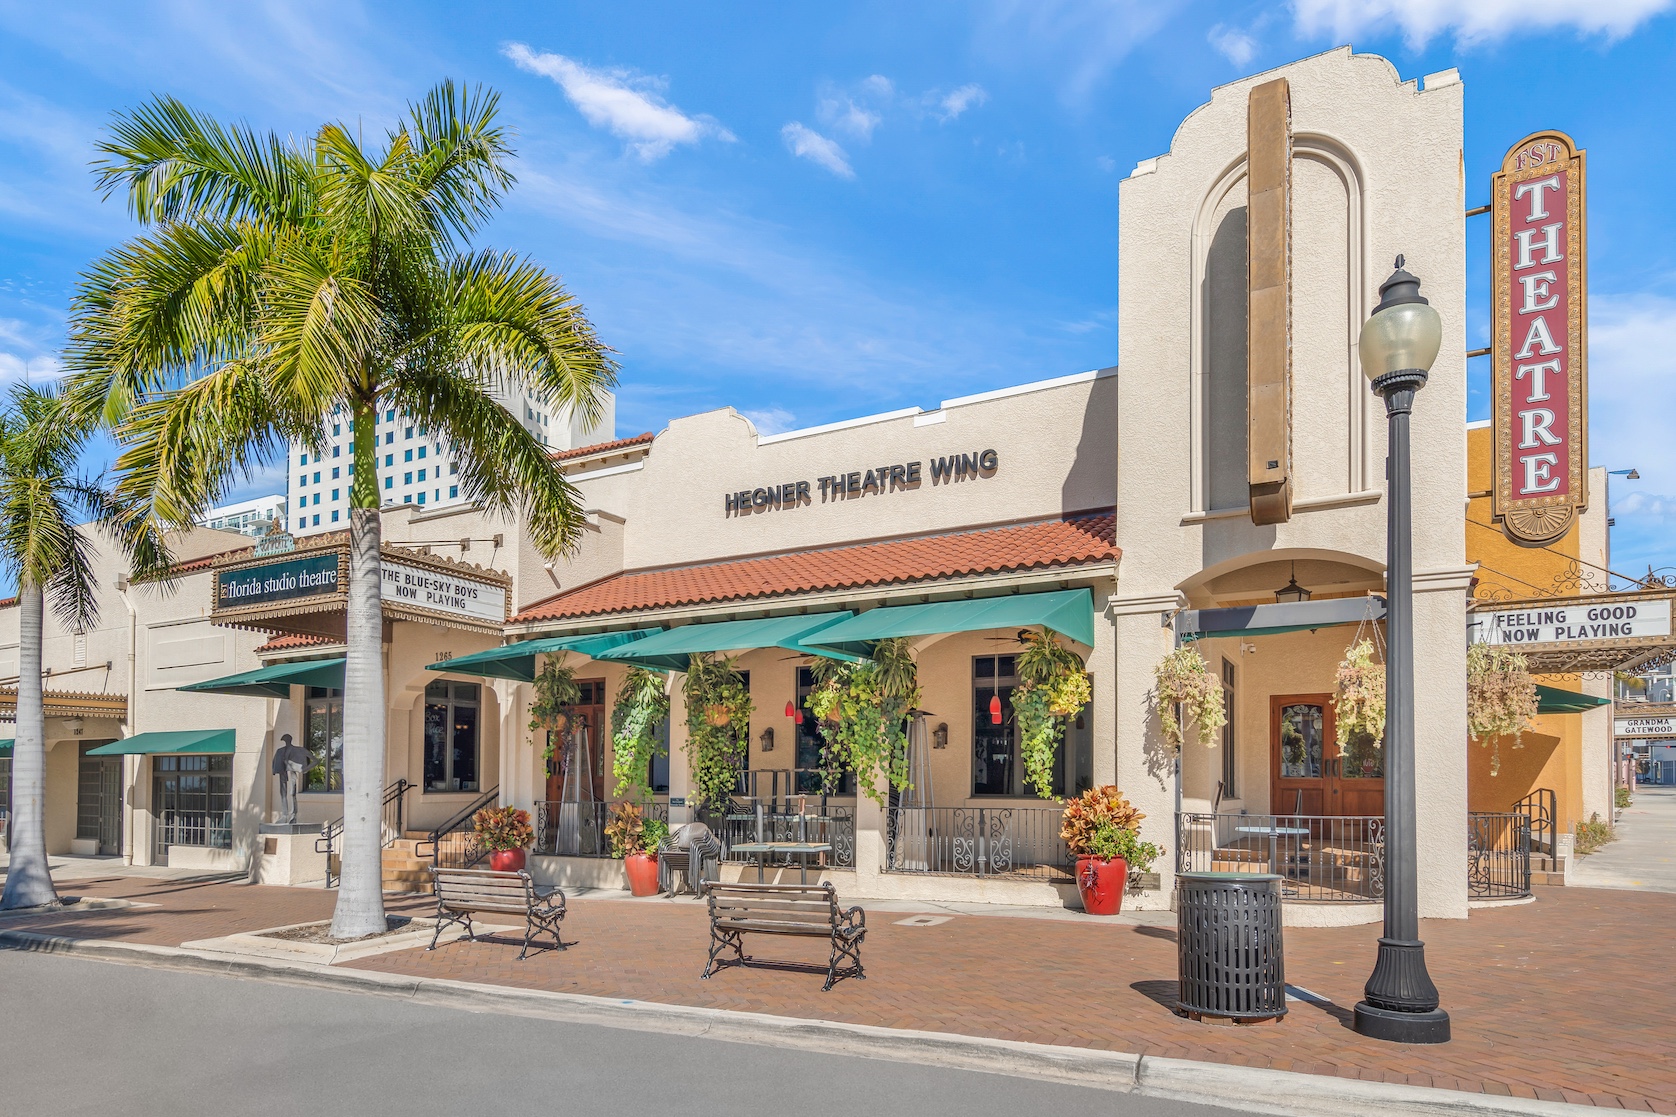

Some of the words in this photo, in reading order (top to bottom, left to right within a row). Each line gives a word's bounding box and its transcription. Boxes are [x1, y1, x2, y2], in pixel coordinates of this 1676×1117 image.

[1515, 143, 1561, 172] FST
[1514, 175, 1564, 495] THEATRE
[725, 480, 811, 512] HEGNER
[818, 461, 922, 497] THEATRE
[930, 449, 998, 478] WING
[228, 578, 261, 599] florida
[264, 572, 297, 593] studio
[299, 569, 337, 588] theatre
[381, 568, 400, 583] THE
[405, 574, 451, 593] BLUE-SKY
[454, 585, 478, 599] BOYS
[396, 585, 417, 599] NOW
[426, 592, 466, 609] PLAYING
[1497, 610, 1566, 628] FEELING
[1587, 606, 1637, 622] GOOD
[1502, 628, 1540, 643] NOW
[1555, 622, 1632, 640] PLAYING
[435, 652, 452, 661] 1265
[1625, 726, 1672, 734] GATEWOOD
[1628, 718, 1670, 727] GRANDMA
